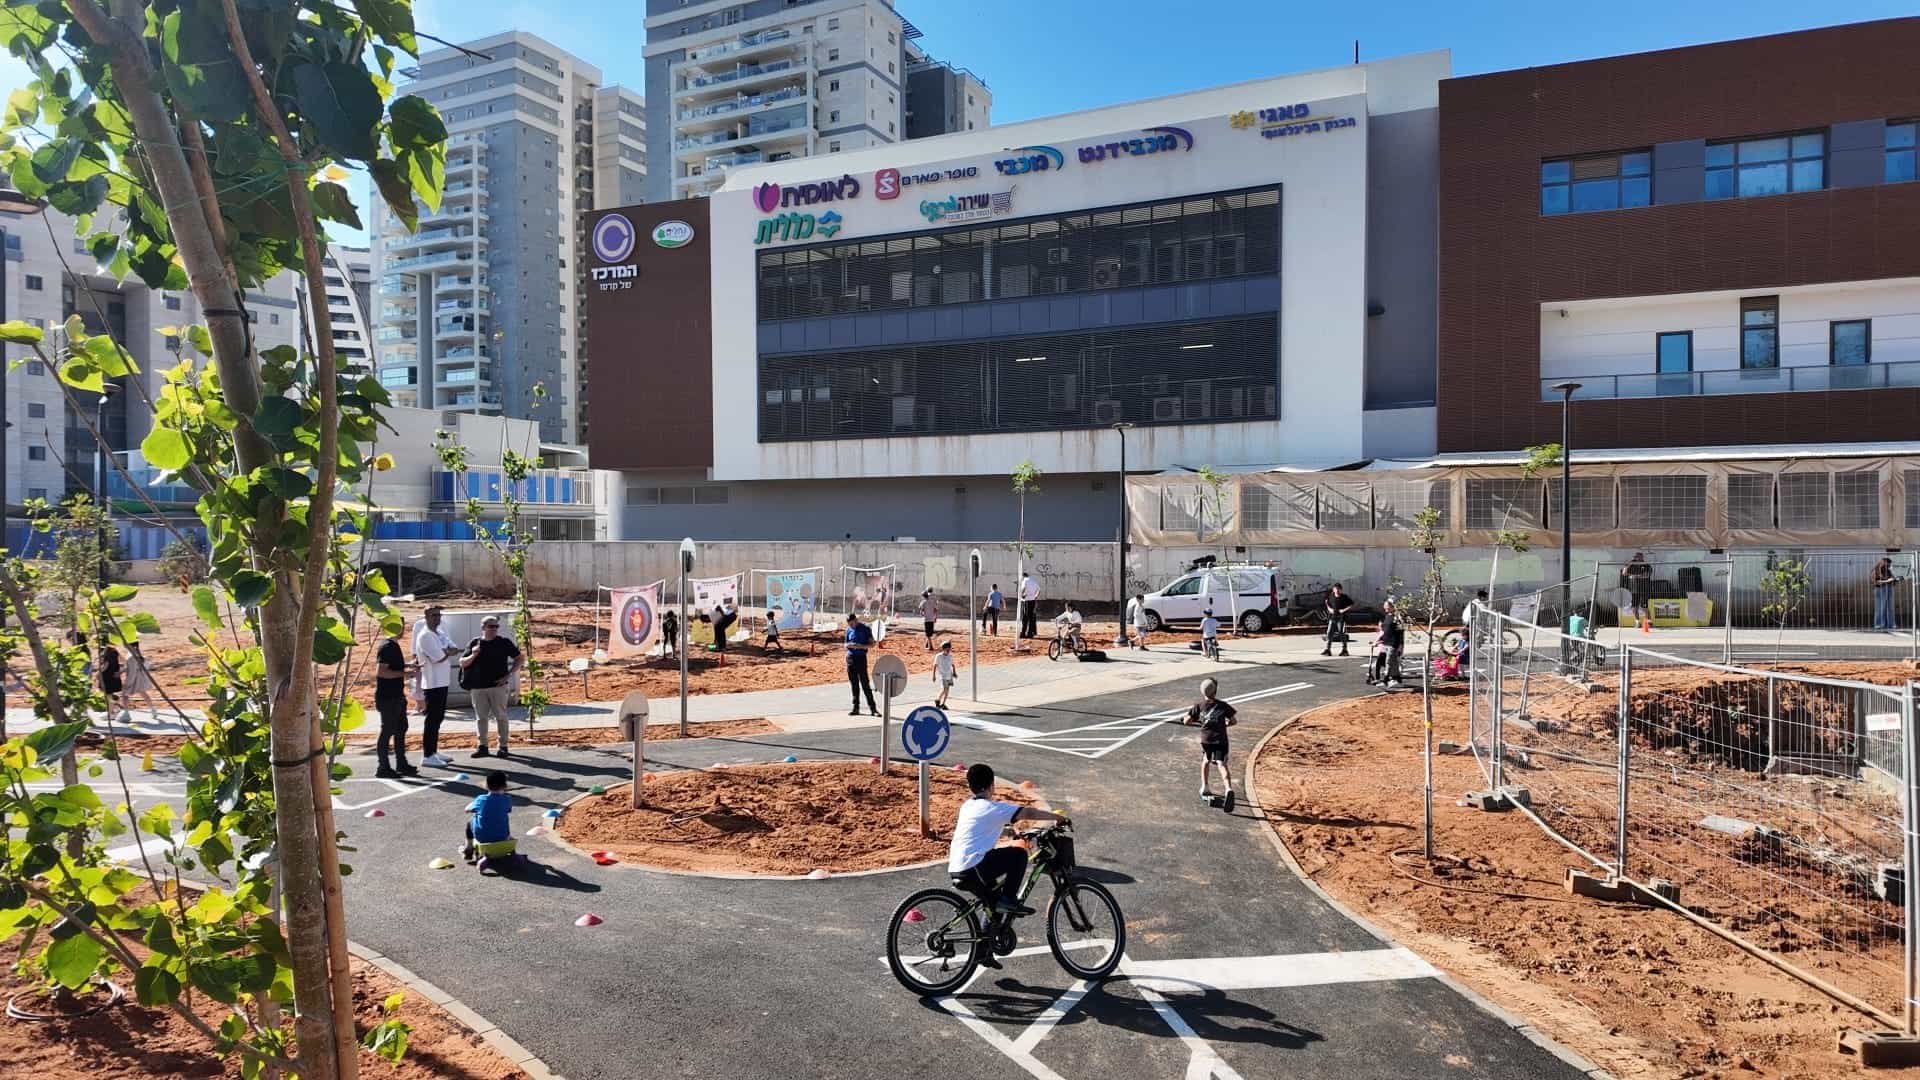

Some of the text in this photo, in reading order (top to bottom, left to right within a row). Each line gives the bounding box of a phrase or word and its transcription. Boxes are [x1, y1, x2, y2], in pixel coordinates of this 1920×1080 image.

[1259, 103, 1310, 122] פאגי
[1324, 117, 1356, 132] הבנק
[1078, 134, 1177, 163] מכבידנט
[994, 154, 1049, 176] מכבי
[781, 174, 860, 208] לאומית
[957, 193, 990, 211] שירה
[754, 212, 815, 245] כללית
[591, 264, 637, 281] המרכז
[619, 281, 632, 290] של
